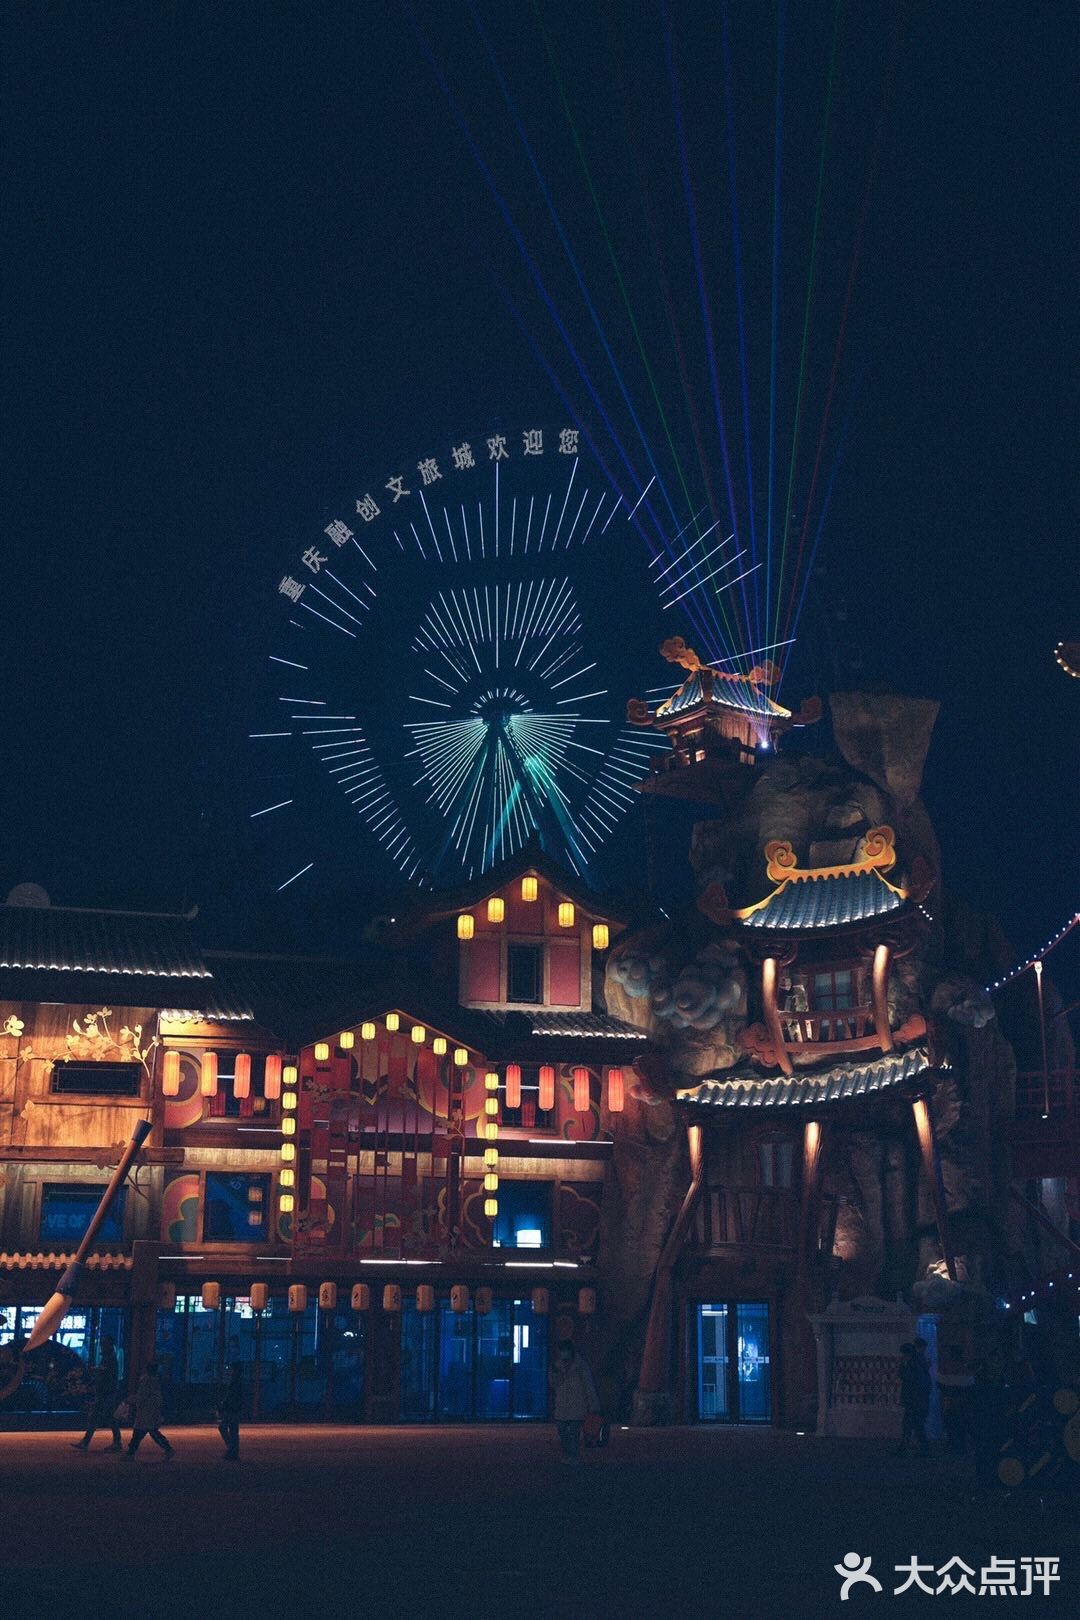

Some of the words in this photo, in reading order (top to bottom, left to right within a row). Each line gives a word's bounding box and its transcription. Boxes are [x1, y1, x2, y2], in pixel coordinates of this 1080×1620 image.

[278, 428, 580, 602] 重庆融创文旅城欢迎您
